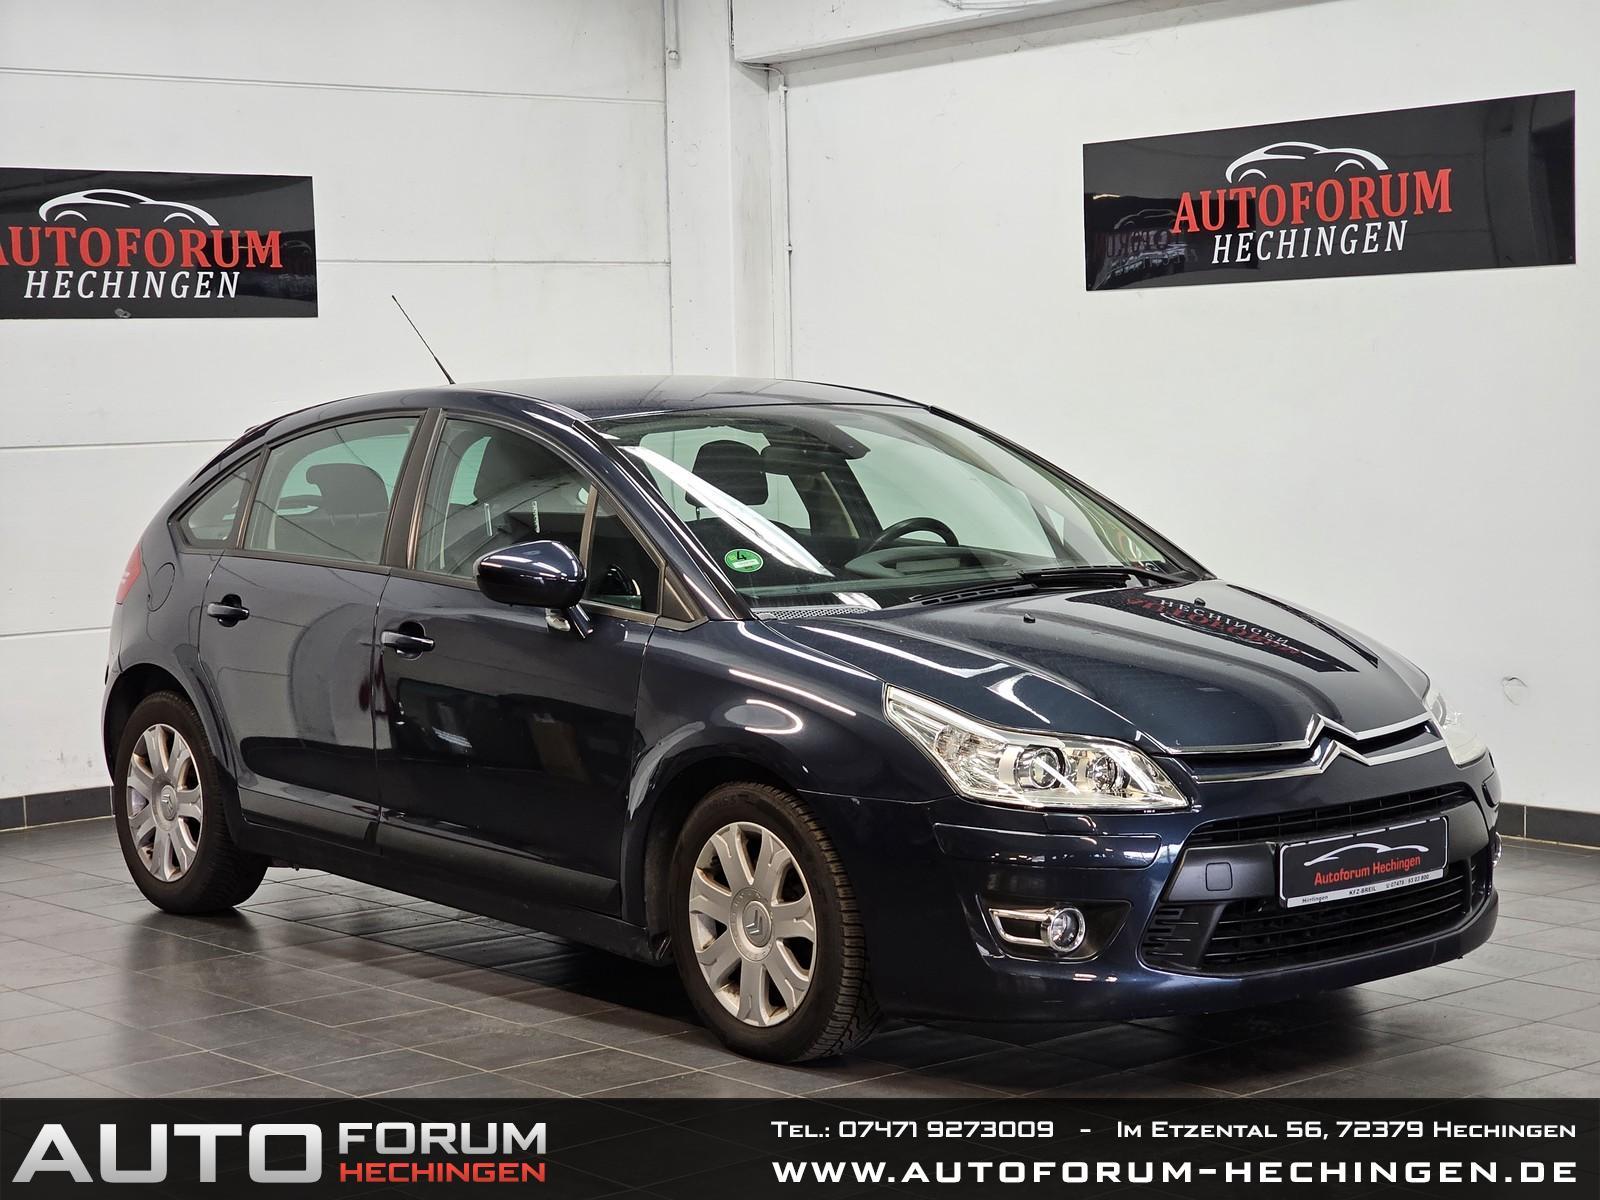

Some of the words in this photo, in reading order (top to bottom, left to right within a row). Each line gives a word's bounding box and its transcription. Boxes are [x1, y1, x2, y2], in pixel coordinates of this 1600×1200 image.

[1171, 168, 1453, 235] AUTOFORUM
[0, 226, 284, 269] UTOFORUM
[1211, 219, 1409, 265] HECHINGEN
[23, 270, 240, 299] HECHINGEN
[1314, 867, 1370, 886] Autoforum
[1372, 855, 1422, 873] Hechingen
